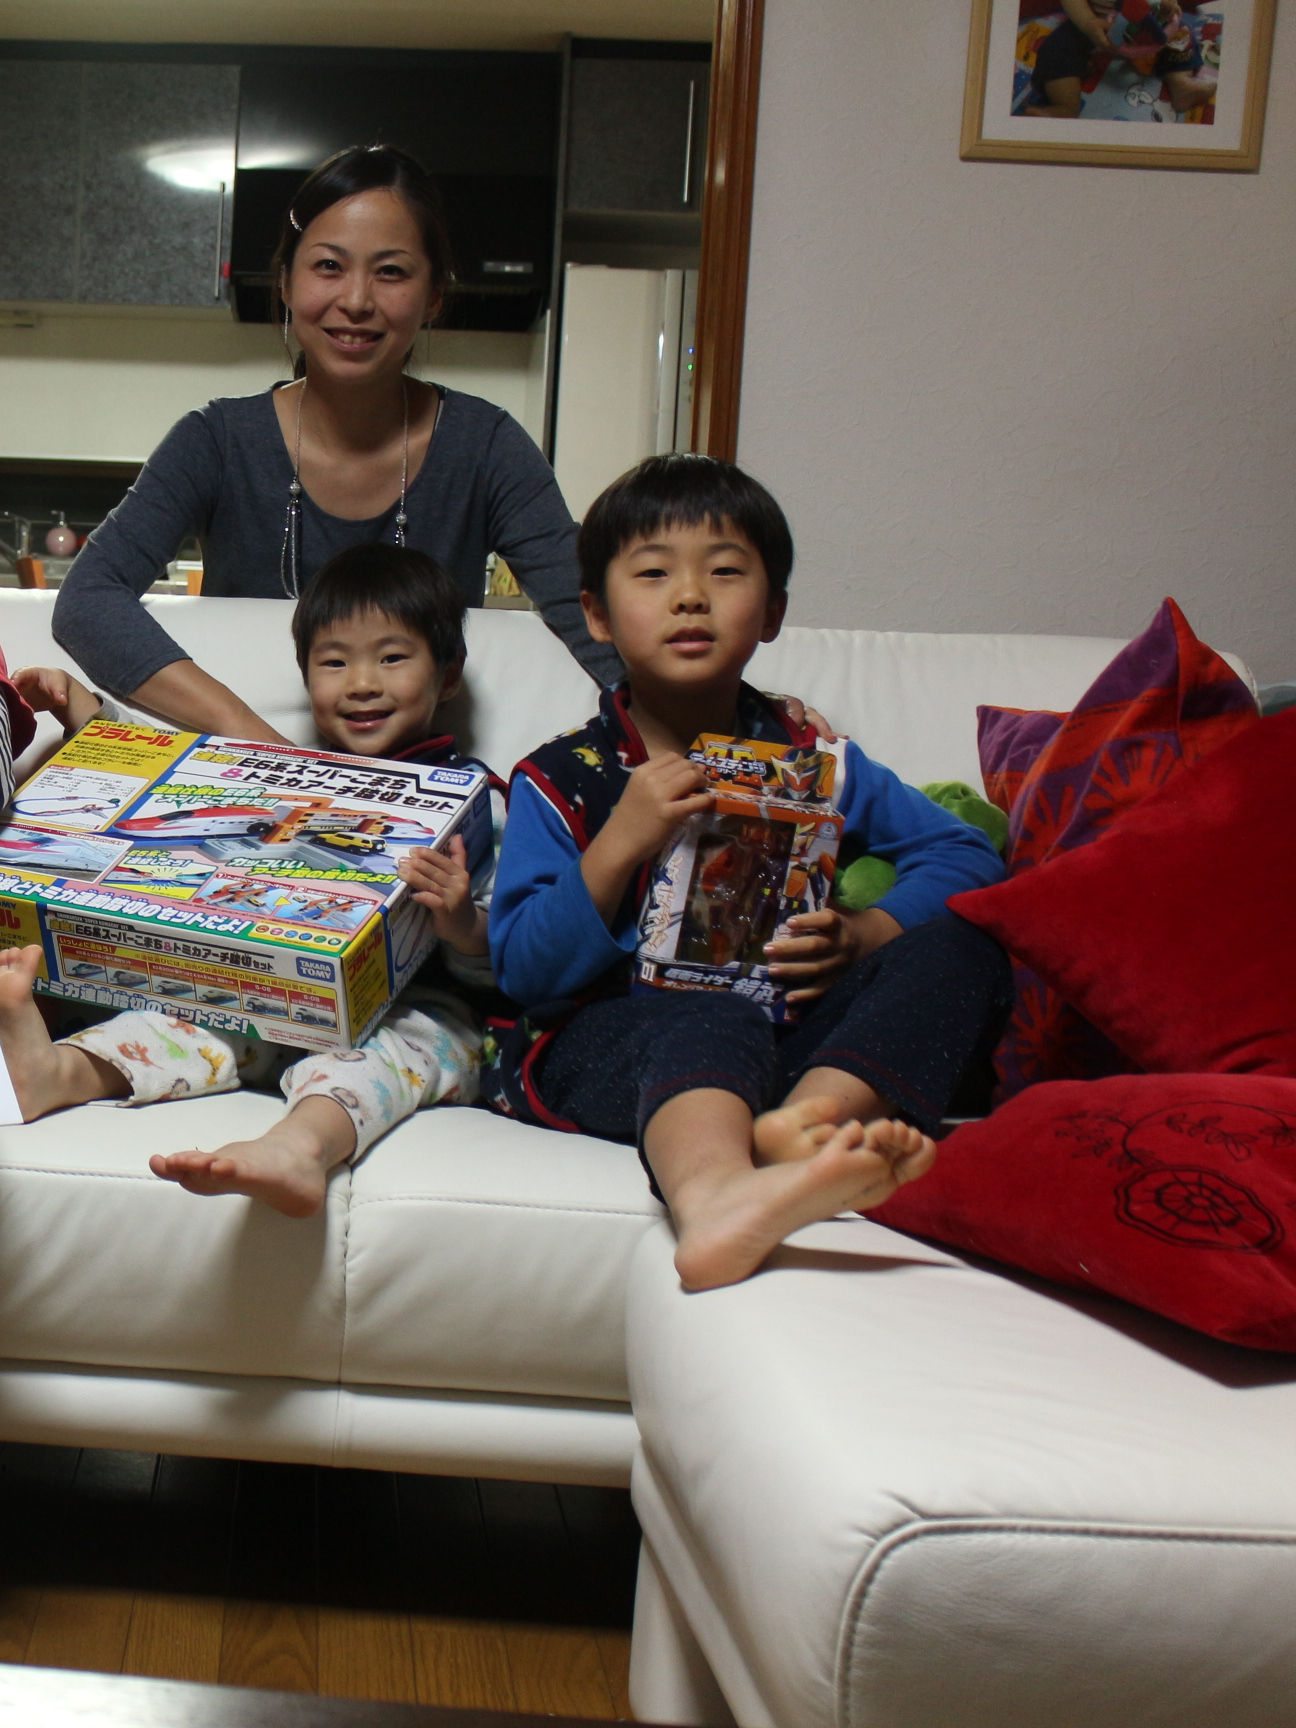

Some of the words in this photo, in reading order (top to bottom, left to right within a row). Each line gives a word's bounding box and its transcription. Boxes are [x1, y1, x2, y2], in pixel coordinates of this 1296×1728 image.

[82, 725, 175, 748] プラレール
[152, 728, 181, 737] TOMY
[433, 775, 467, 785] TOMY
[436, 770, 470, 781] TAKARA
[225, 856, 307, 871] カッコいい
[299, 959, 330, 973] TAKARA
[640, 960, 655, 983] 01
[301, 967, 332, 980] TOMY
